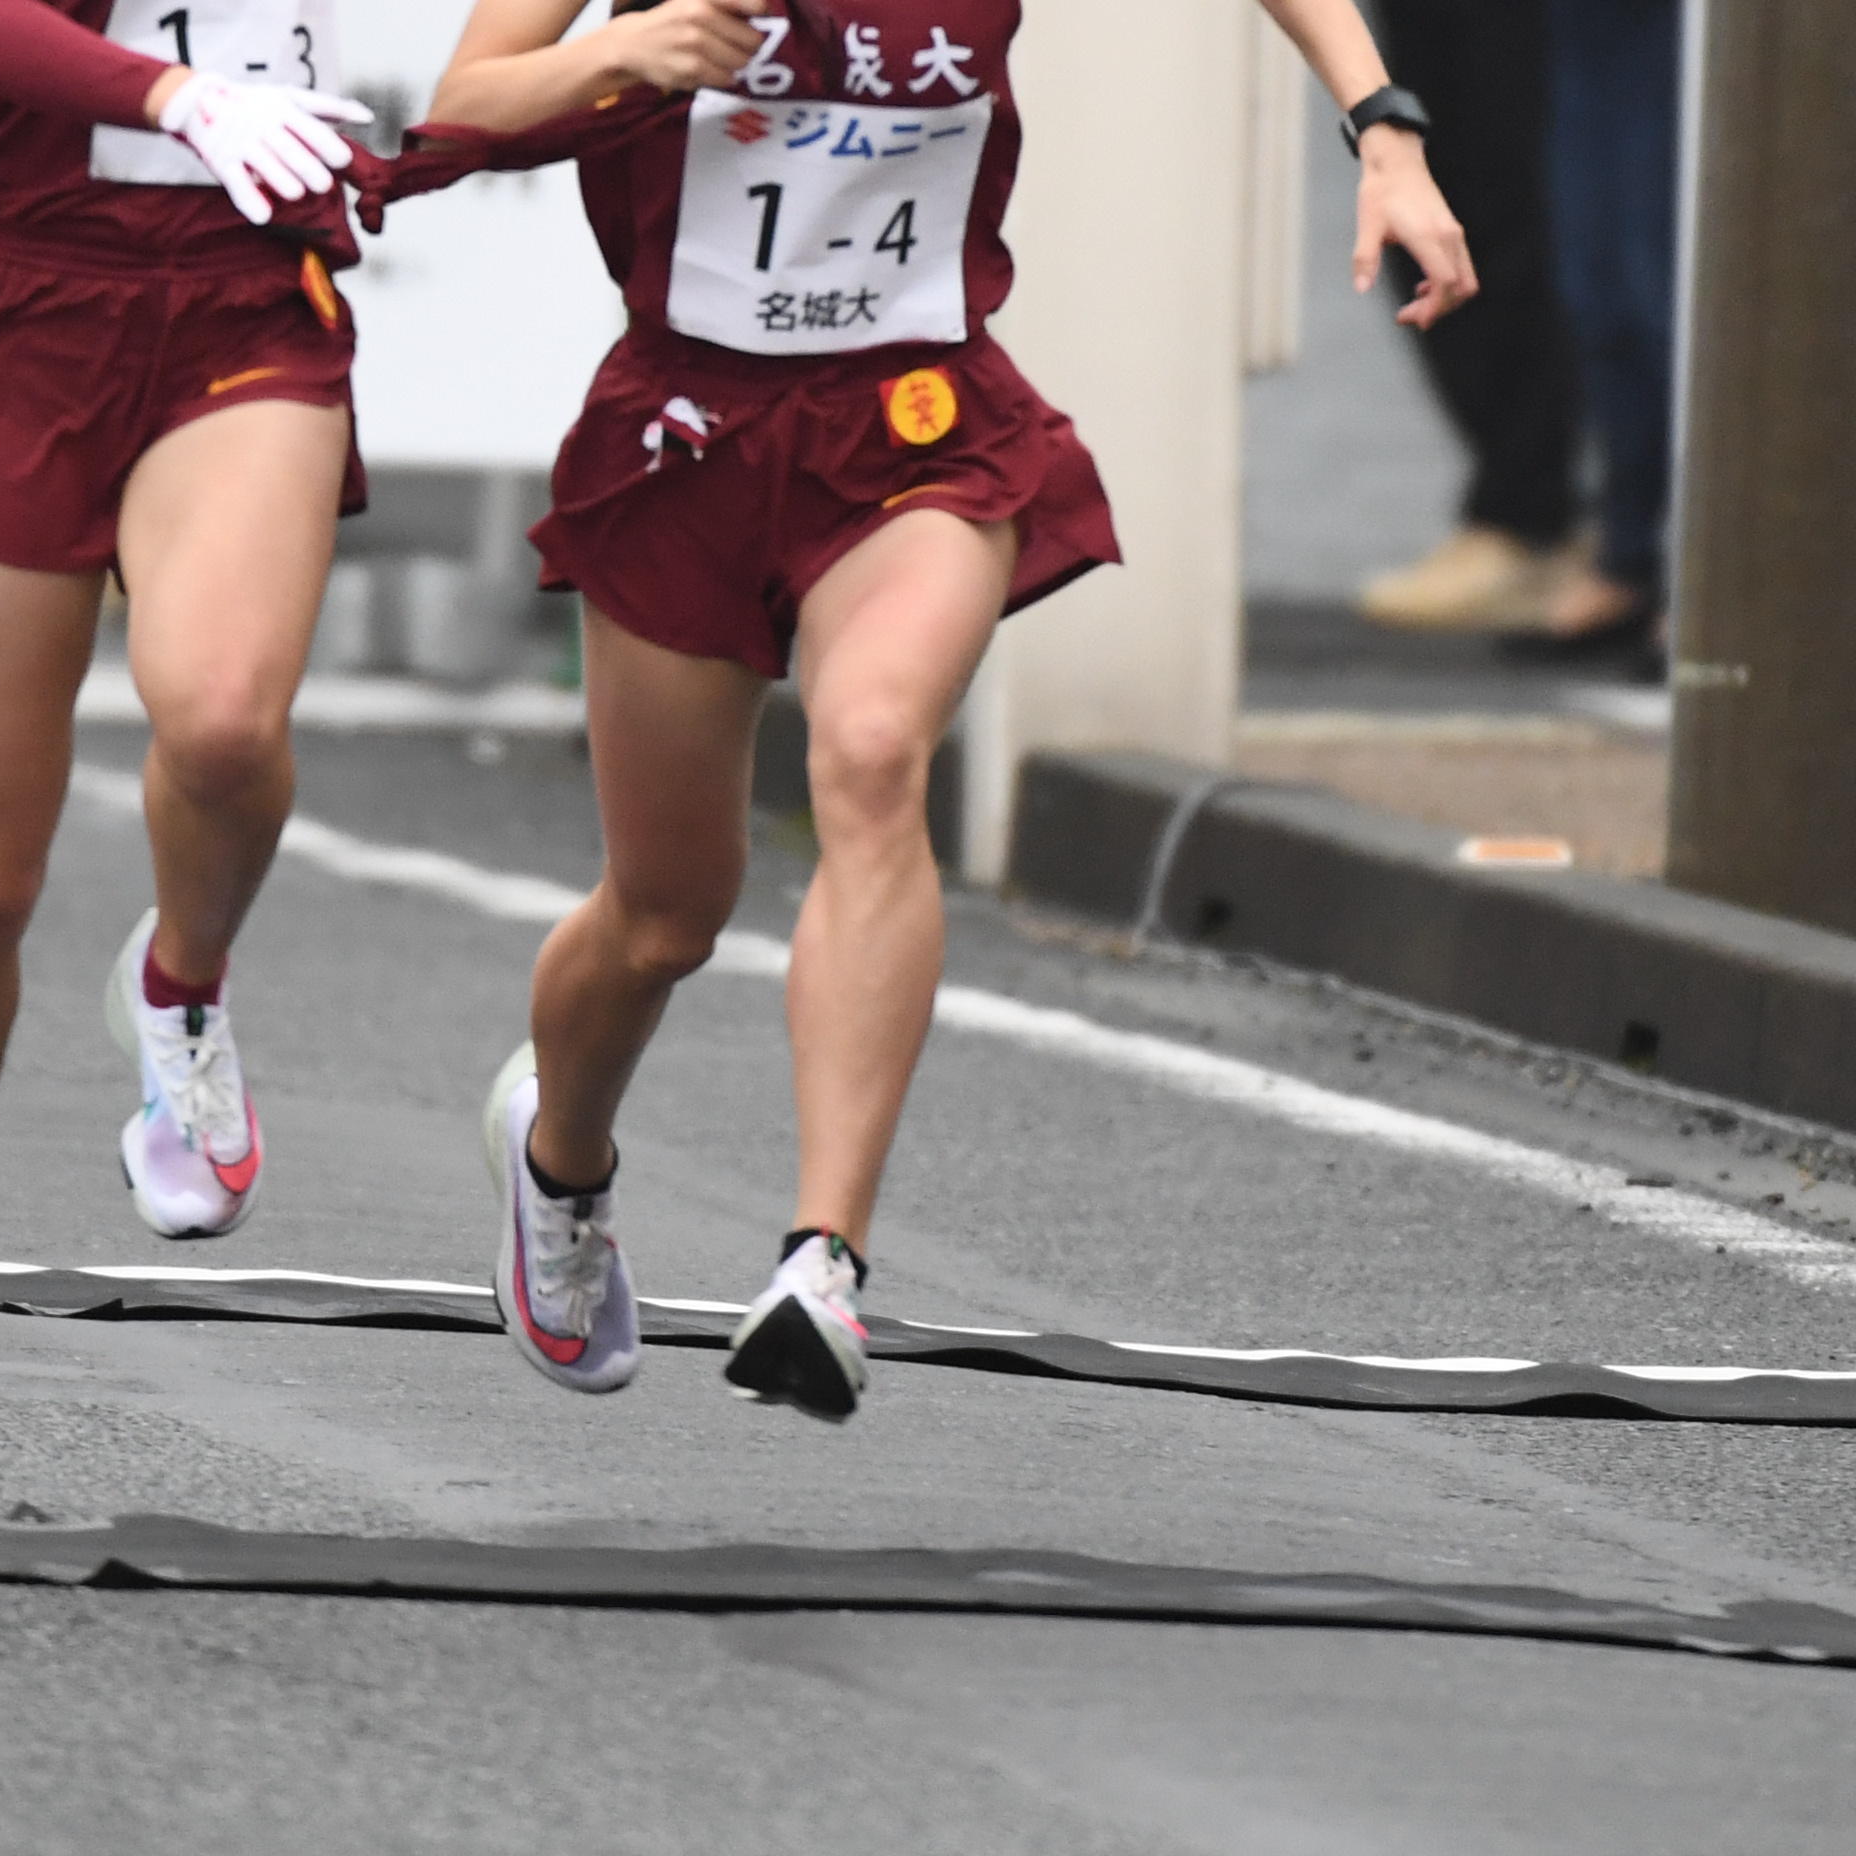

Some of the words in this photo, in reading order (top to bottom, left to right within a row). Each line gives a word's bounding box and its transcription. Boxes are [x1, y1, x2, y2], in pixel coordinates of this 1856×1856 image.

[785, 110, 967, 158] ジムニー
[755, 288, 881, 332] 名城大
